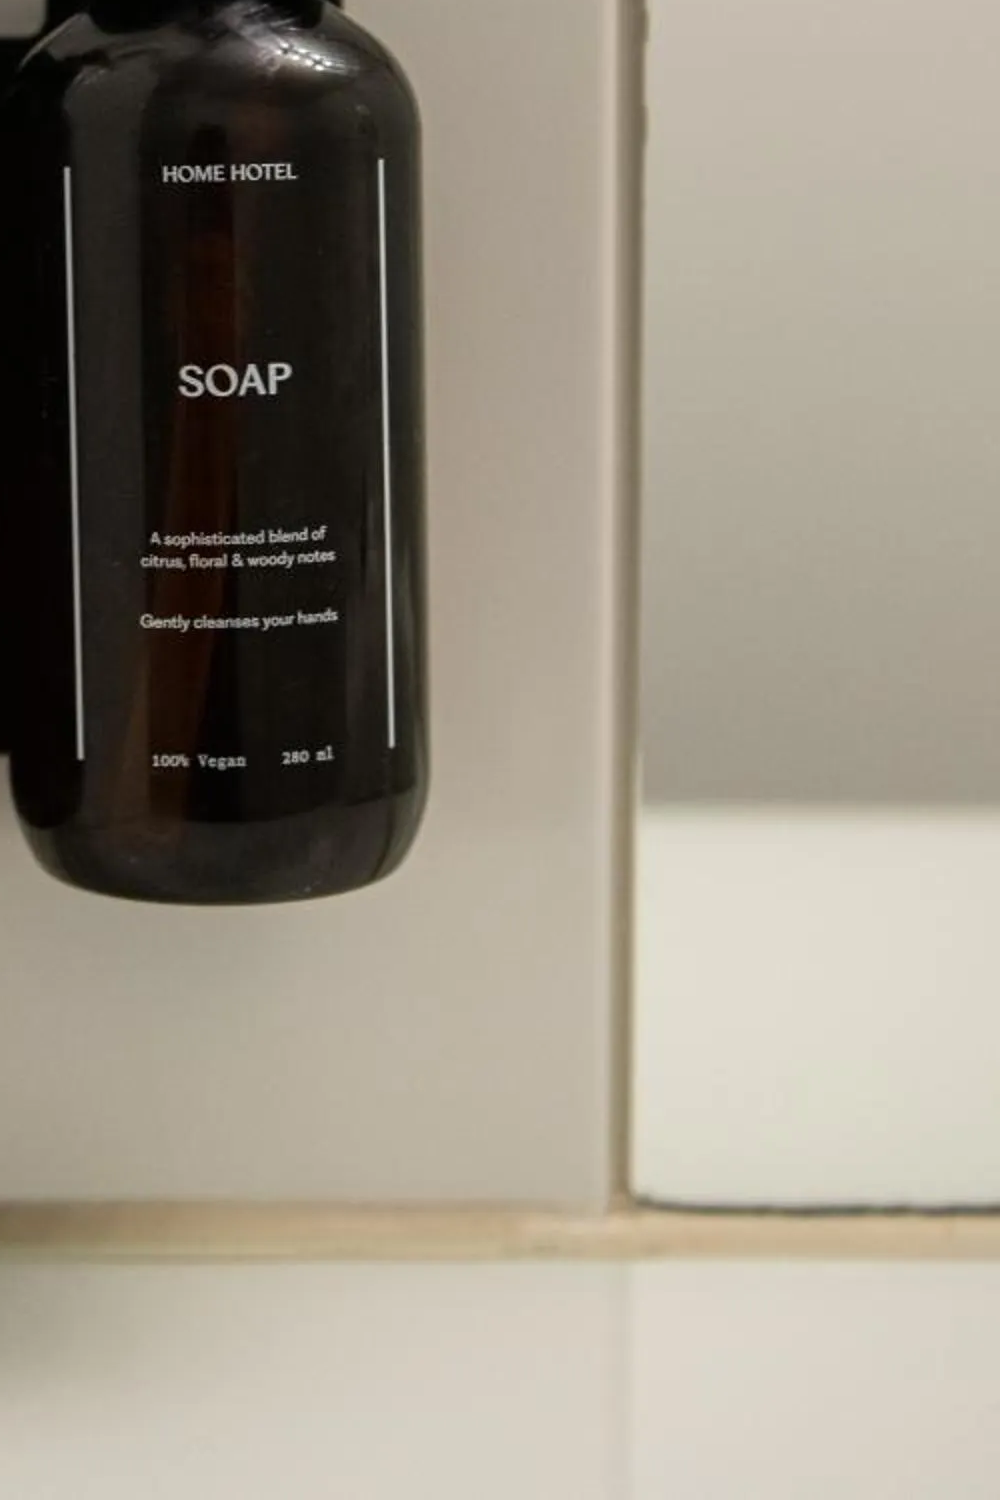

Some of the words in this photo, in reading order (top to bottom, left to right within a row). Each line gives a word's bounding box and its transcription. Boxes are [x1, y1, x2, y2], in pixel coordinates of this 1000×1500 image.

[161, 163, 227, 184] HOME
[229, 162, 299, 182] HOTEL
[177, 361, 294, 399] SOAP
[149, 530, 161, 546] A
[163, 529, 265, 548] sophisticated
[267, 526, 310, 545] blend
[309, 524, 329, 542] of
[139, 553, 188, 572] citrus,
[187, 552, 229, 570] floral
[231, 553, 244, 568] &
[246, 551, 295, 569] woody
[295, 549, 338, 565] notes
[139, 612, 192, 634] Gently
[192, 613, 261, 630] cleanses
[261, 614, 296, 632] your
[296, 606, 339, 625] hands
[151, 753, 191, 768] 100%
[196, 753, 248, 771] Vegan
[281, 748, 311, 766] 280
[314, 744, 335, 762] ml
